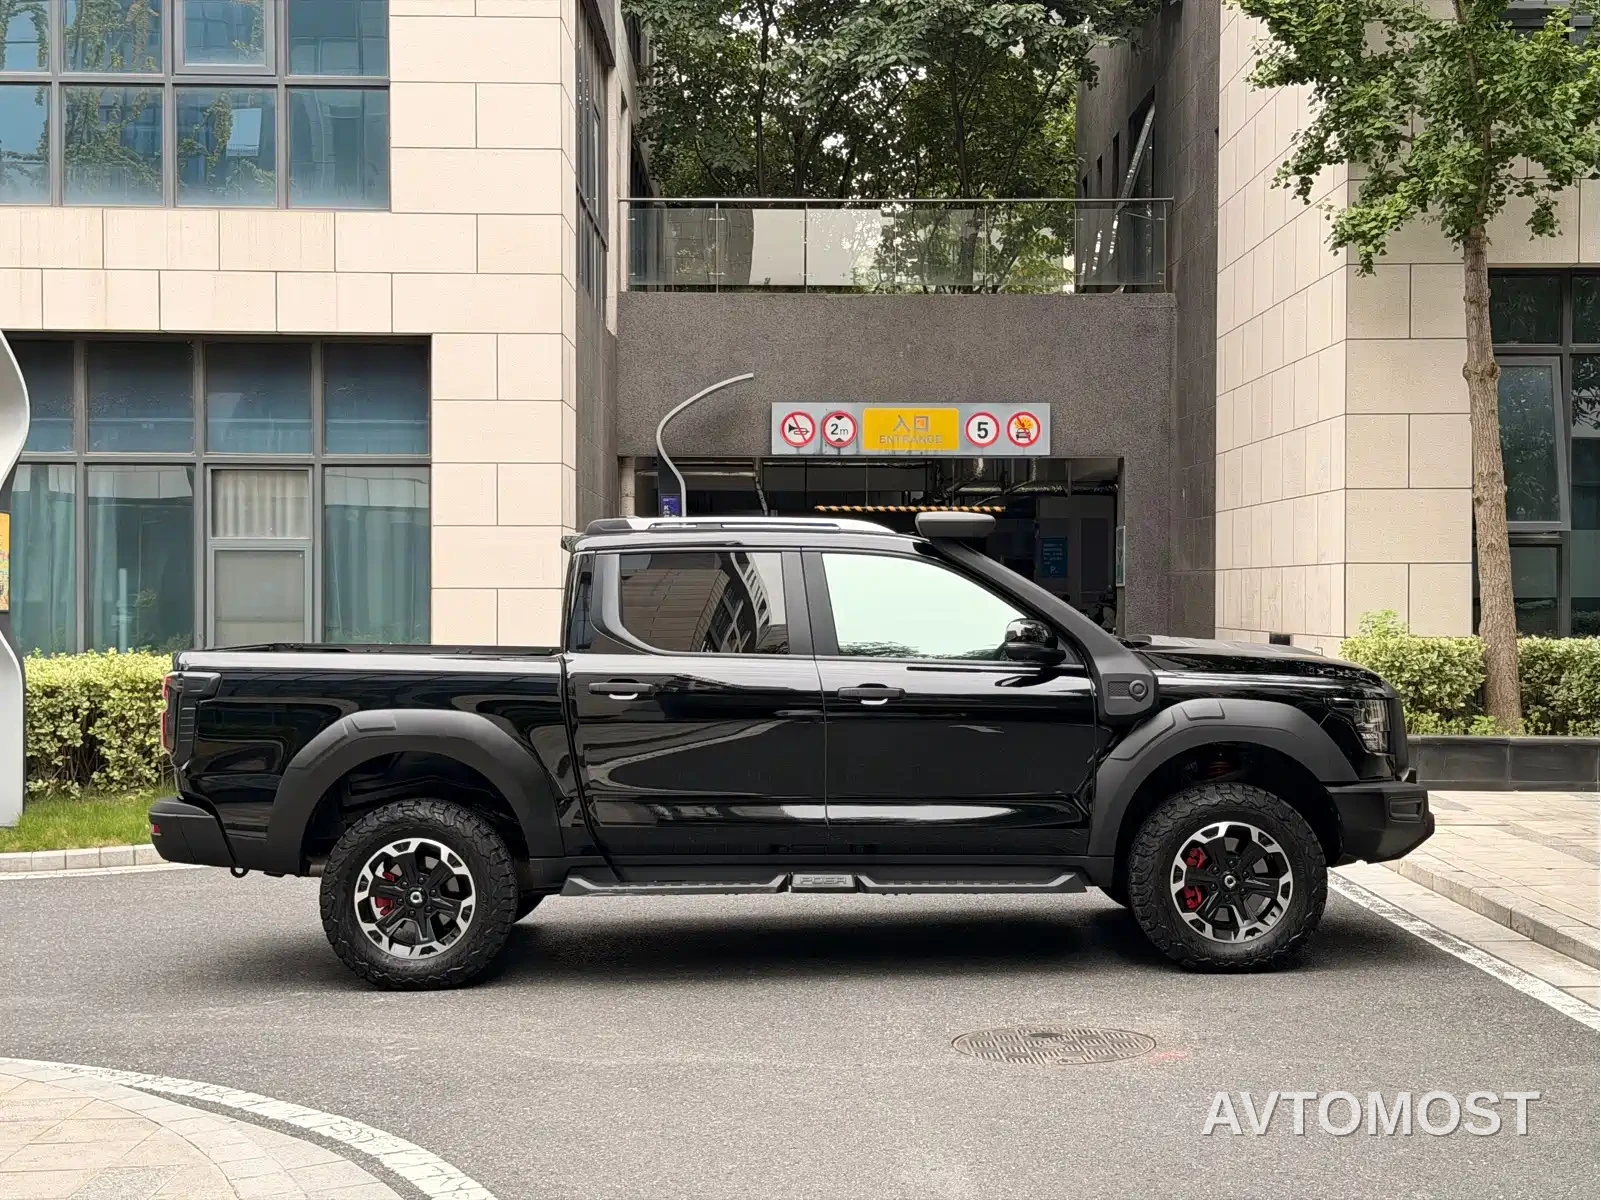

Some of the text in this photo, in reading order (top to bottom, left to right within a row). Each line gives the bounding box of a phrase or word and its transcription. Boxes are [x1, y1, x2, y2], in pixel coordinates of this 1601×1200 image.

[830, 423, 849, 435] 2m
[893, 414, 929, 432] 入口
[977, 421, 989, 439] 5
[879, 434, 943, 444] ENTRANCE
